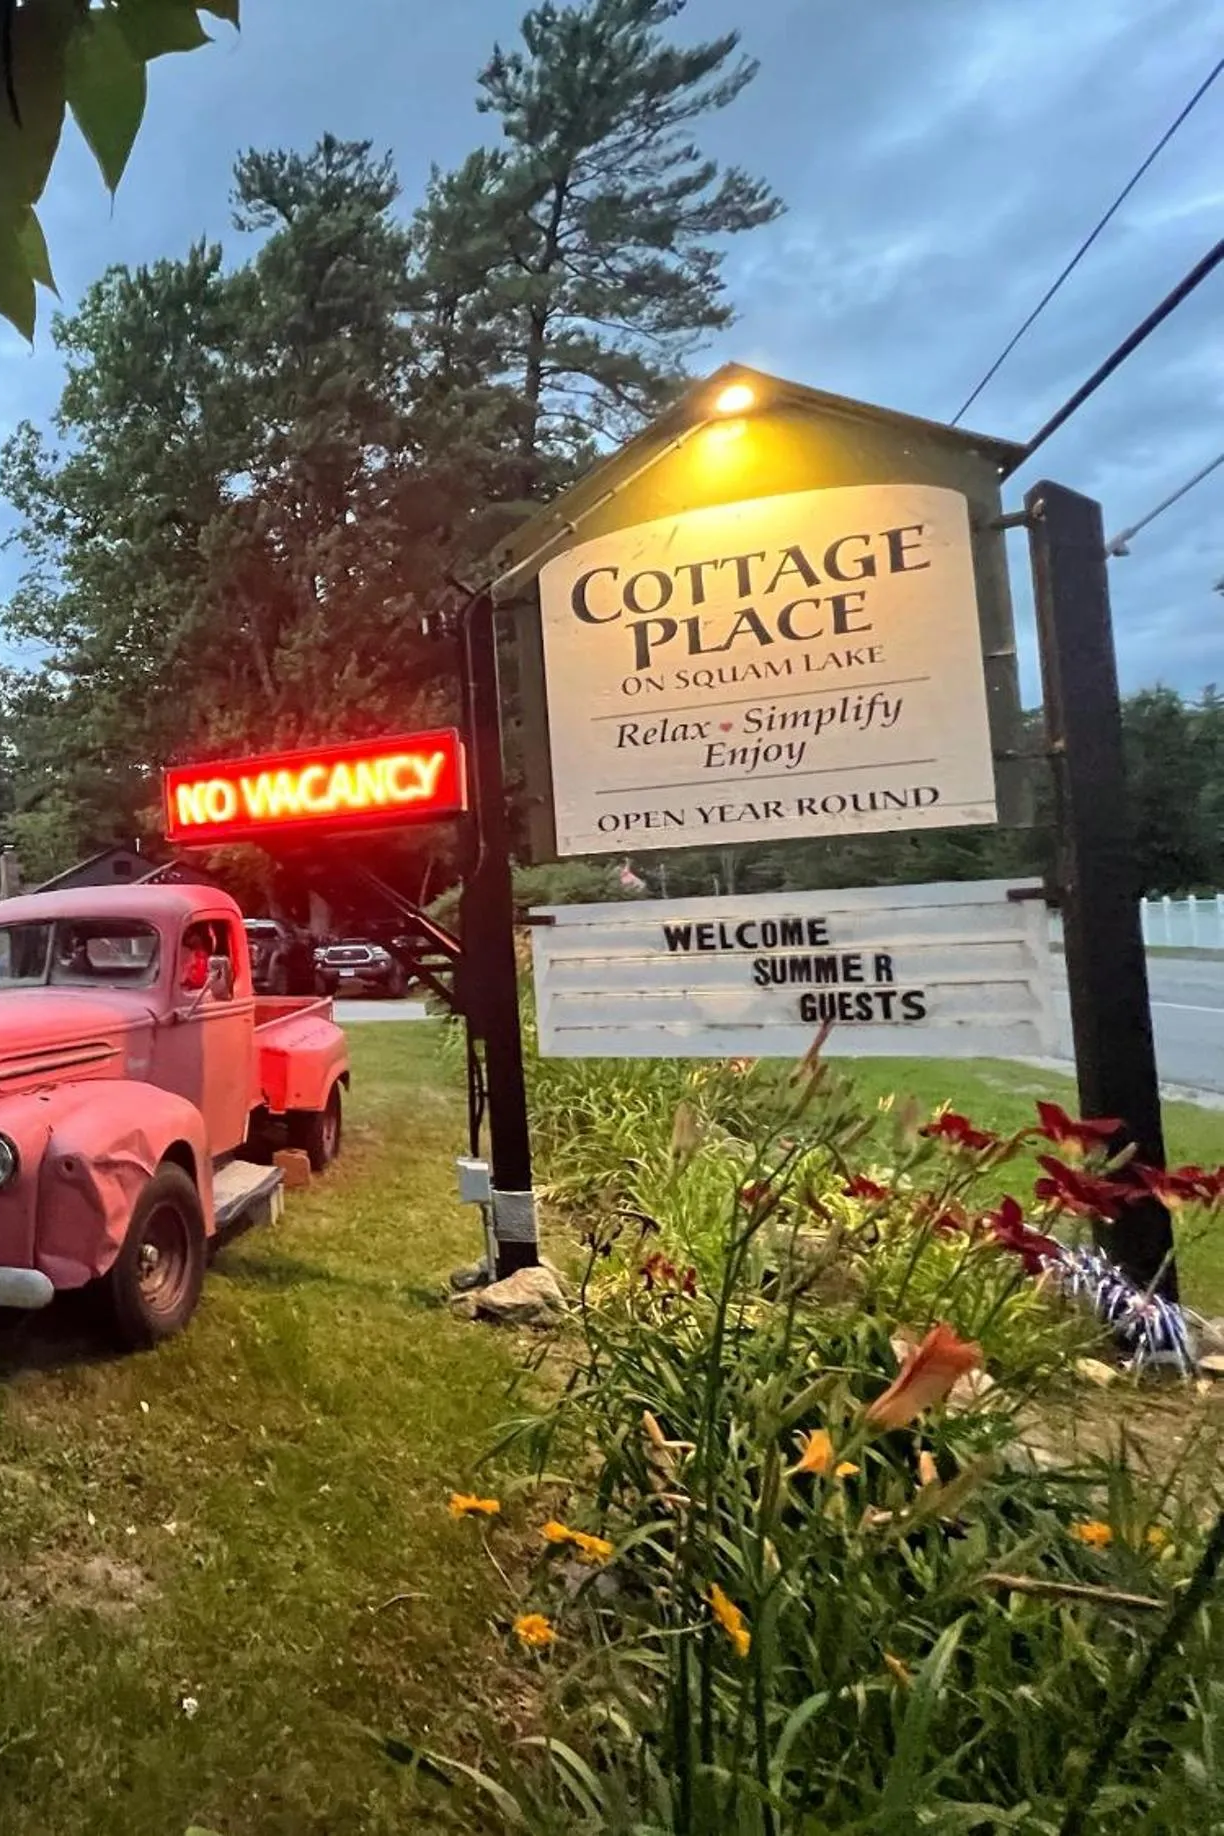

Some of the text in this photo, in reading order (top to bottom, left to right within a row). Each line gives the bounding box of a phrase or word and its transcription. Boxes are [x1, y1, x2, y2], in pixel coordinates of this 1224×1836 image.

[571, 524, 931, 624] COTTAGE
[625, 591, 873, 671] PLACE
[622, 645, 887, 697] ON SQUAM LAKE
[616, 692, 903, 748] Relax Simplify
[703, 741, 807, 773] Enjoy
[175, 750, 445, 826] NO VACANCY
[597, 785, 941, 832] OPEN YEAR ROUND
[663, 917, 830, 951] WELCOME
[799, 989, 927, 1022] GUESTS
